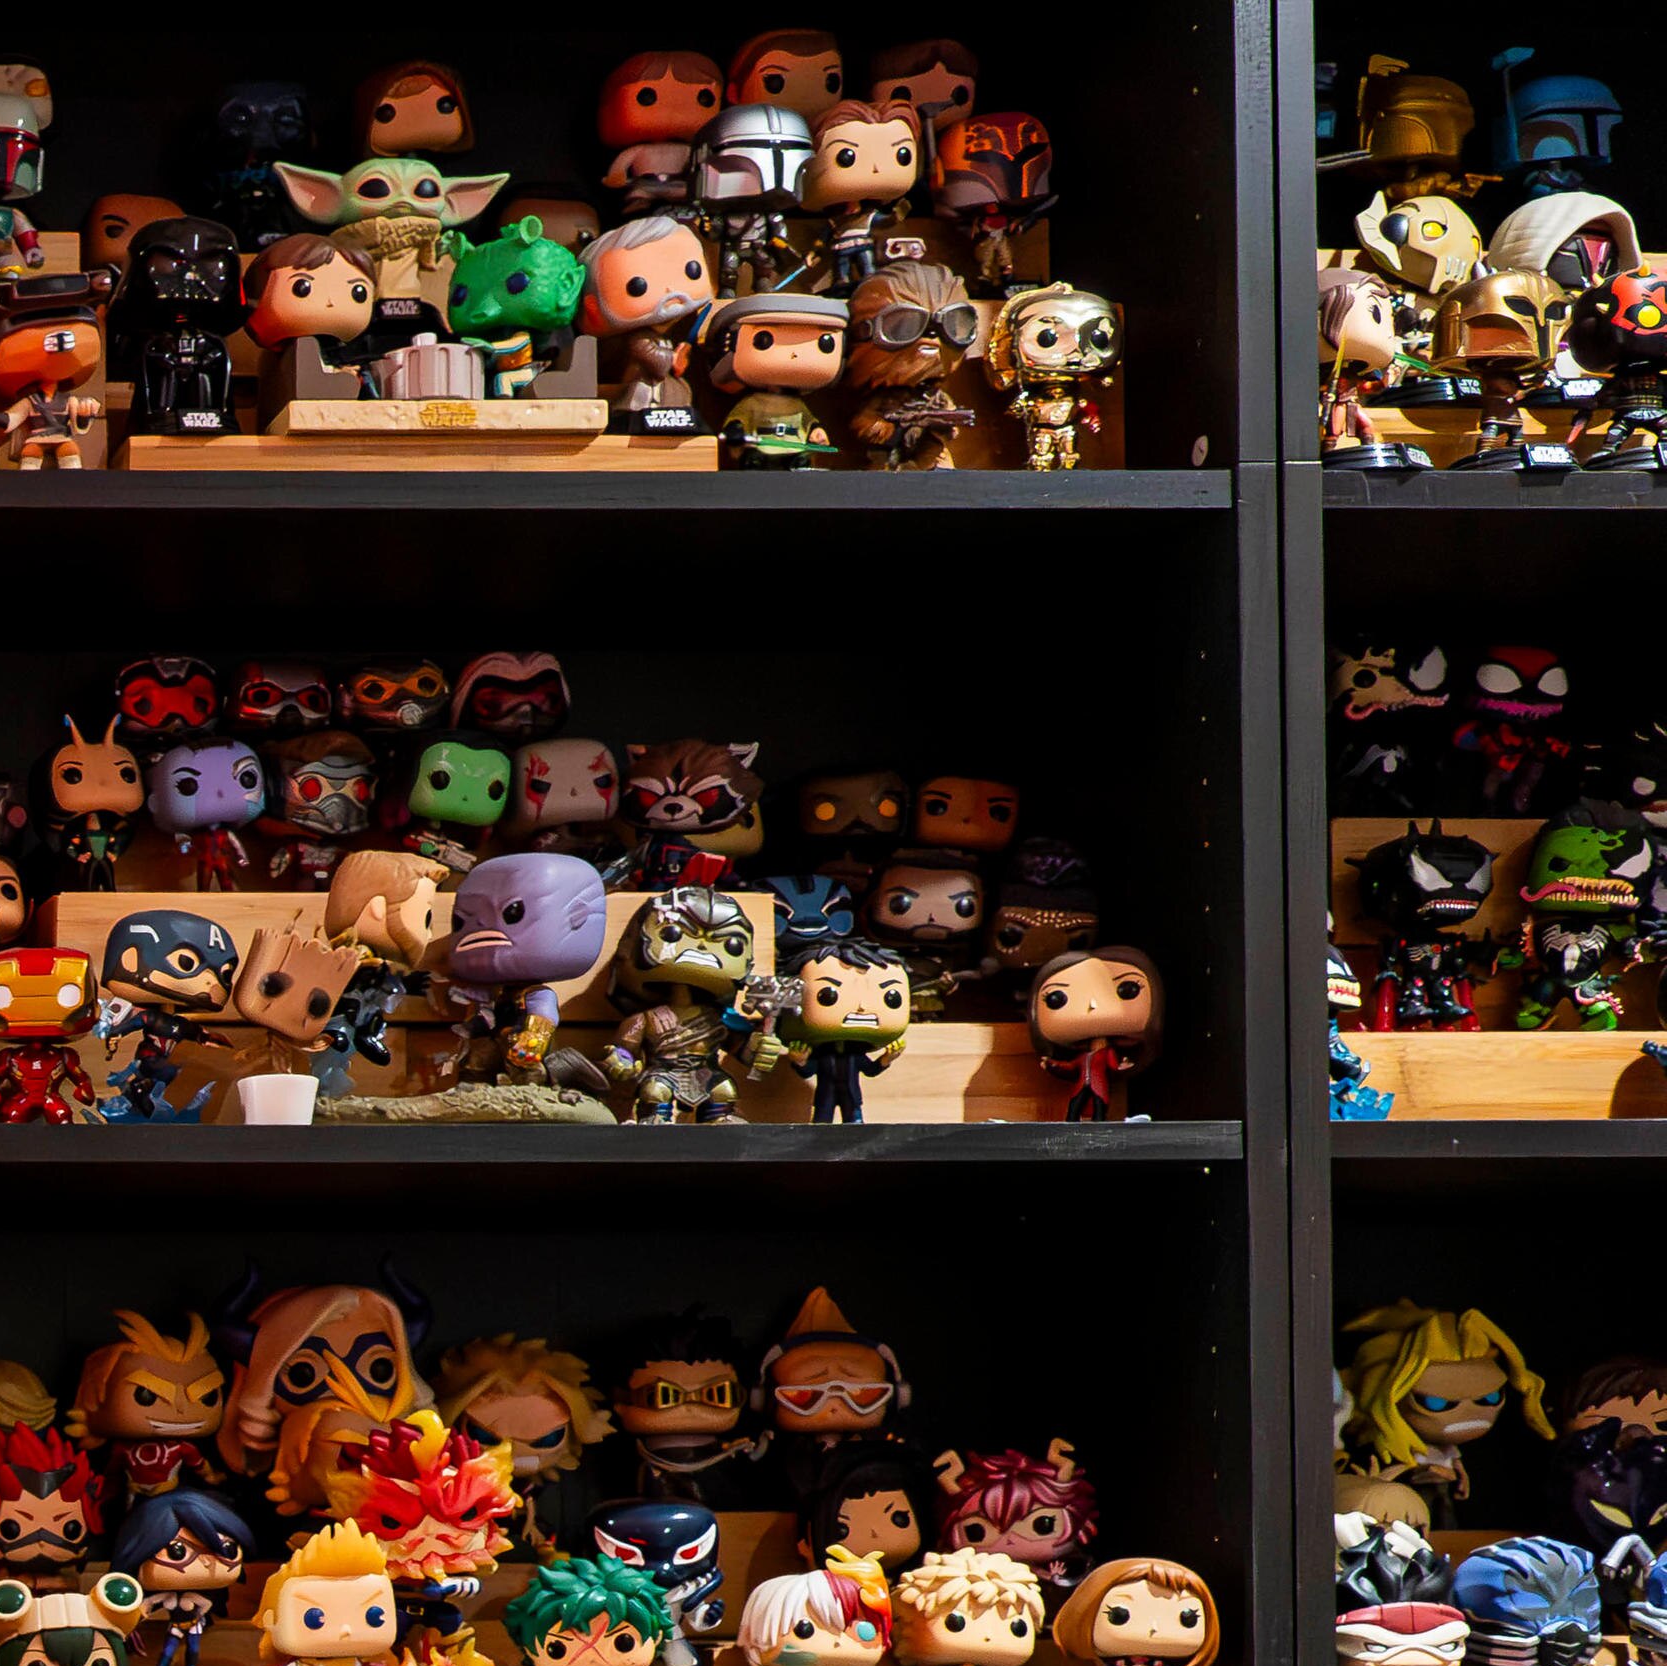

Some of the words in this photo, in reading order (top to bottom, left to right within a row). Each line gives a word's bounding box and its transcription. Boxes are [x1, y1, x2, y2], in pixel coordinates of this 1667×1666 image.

[182, 412, 220, 420] STAR
[645, 409, 691, 419] STAR
[183, 419, 223, 427] WARS
[645, 418, 695, 428] WARS
[208, 924, 227, 952] A
